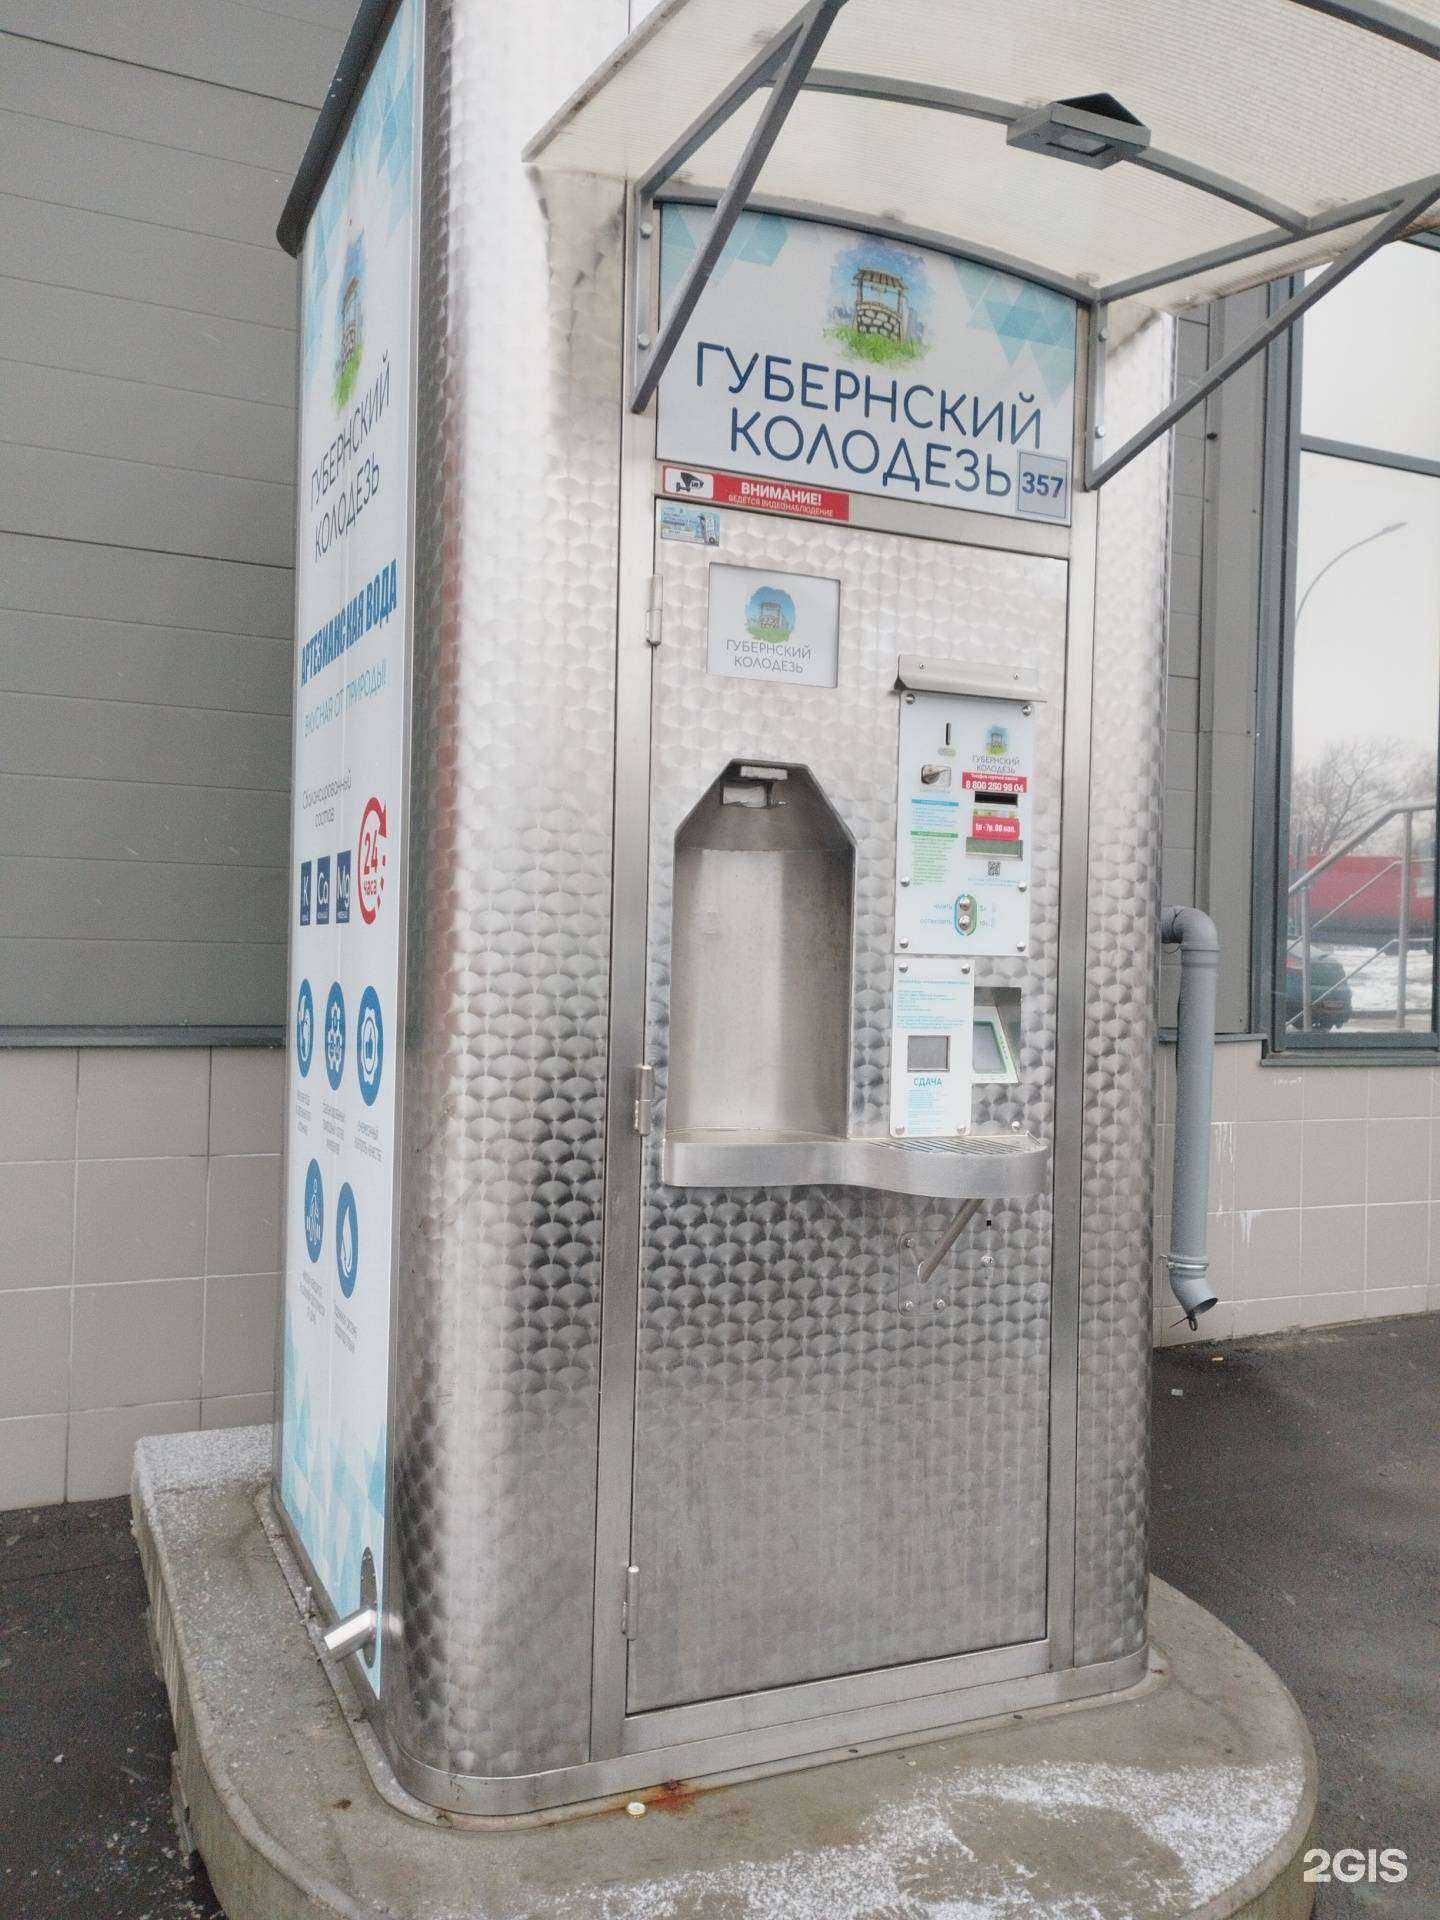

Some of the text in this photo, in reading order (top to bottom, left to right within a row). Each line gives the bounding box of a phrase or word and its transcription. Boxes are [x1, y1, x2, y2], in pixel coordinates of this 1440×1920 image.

[697, 341, 1041, 449] ГУБЕРНСКИЙ
[311, 349, 390, 511] ГУБЕРНСКИЙ
[731, 407, 1012, 497] КОЛОДЕЗЬ
[741, 482, 822, 506] ВНИМАНИЕ!
[1022, 472, 1064, 499] 357
[314, 452, 380, 562] КОЛОДЕЗЬ
[762, 499, 833, 517] ВИДЕОНАБЛЮДЕНИЕ
[301, 558, 397, 687] АРТЕЗИАНСКАЯ ВОДА
[726, 639, 812, 660] ГУБЕРНСКИЙ
[734, 656, 804, 674] КОЛОДЕЗЬ
[972, 754, 1020, 765] ГУБЕРНСКИЙ
[976, 764, 1016, 774] КОЛОДЕЗЬ
[966, 780, 971, 789] 8
[364, 829, 378, 875] 24
[303, 866, 350, 910] K Ca Mg
[364, 879, 377, 896] часа
[913, 1077, 943, 1087] СДАЧА
